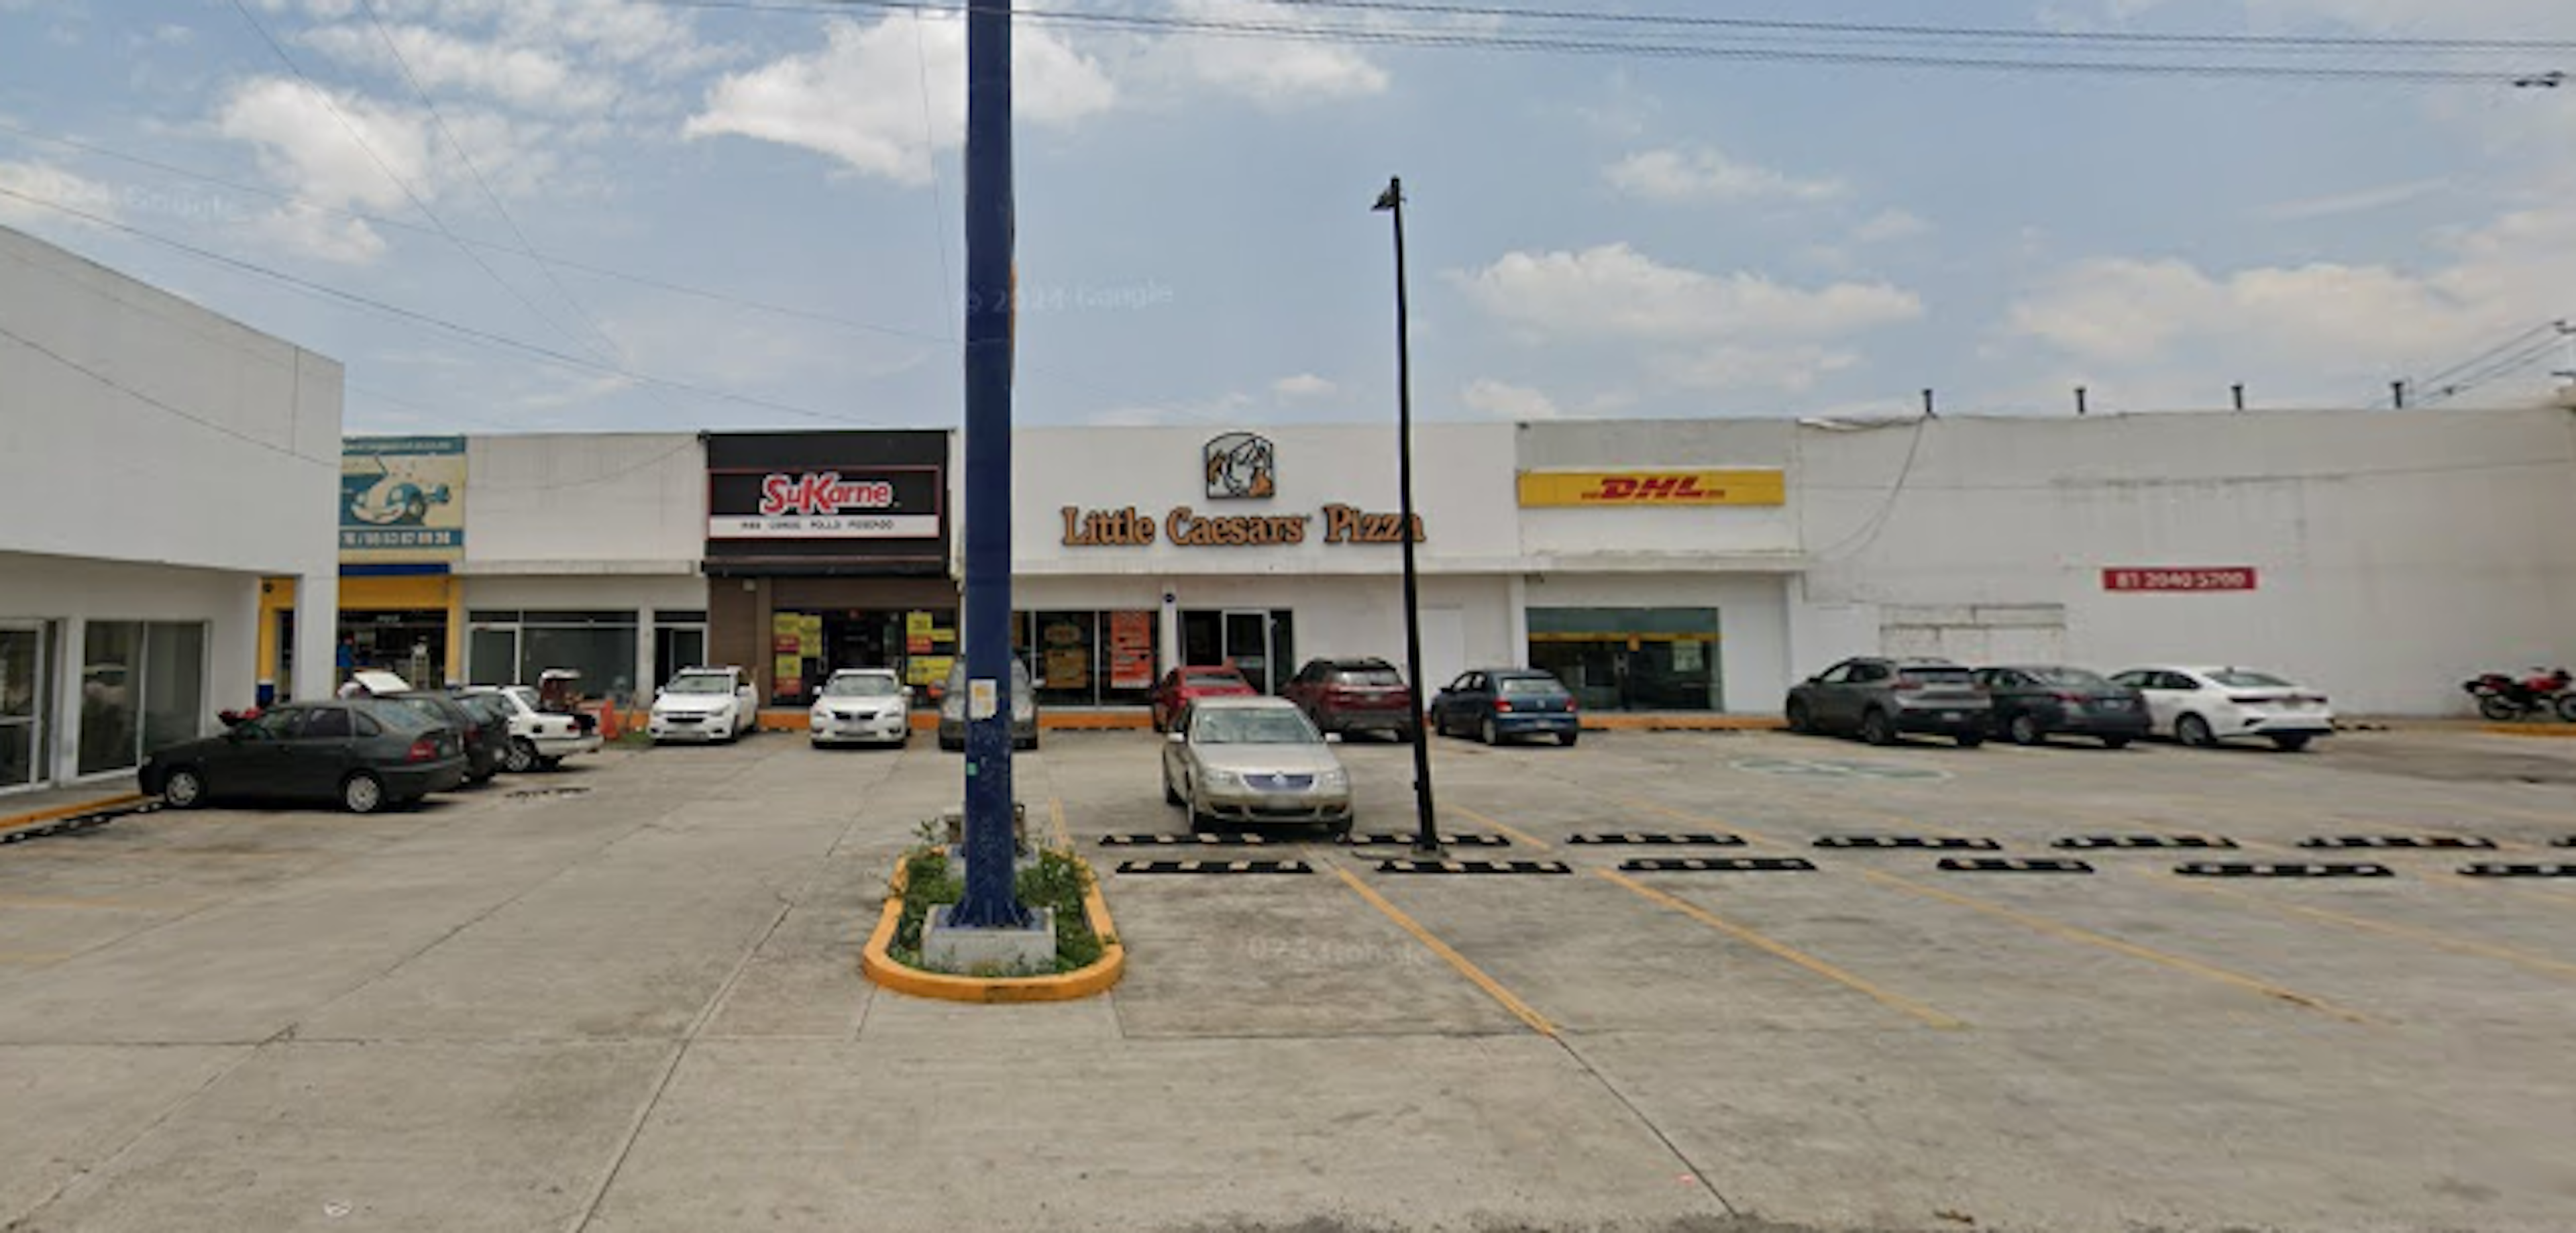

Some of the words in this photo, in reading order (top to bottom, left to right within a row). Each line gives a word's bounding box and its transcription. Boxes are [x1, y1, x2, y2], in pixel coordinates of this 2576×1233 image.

[760, 472, 893, 515] SuKarne
[1600, 476, 1702, 500] DHL
[1062, 506, 1155, 547] Little
[1166, 506, 1305, 547] Caesars
